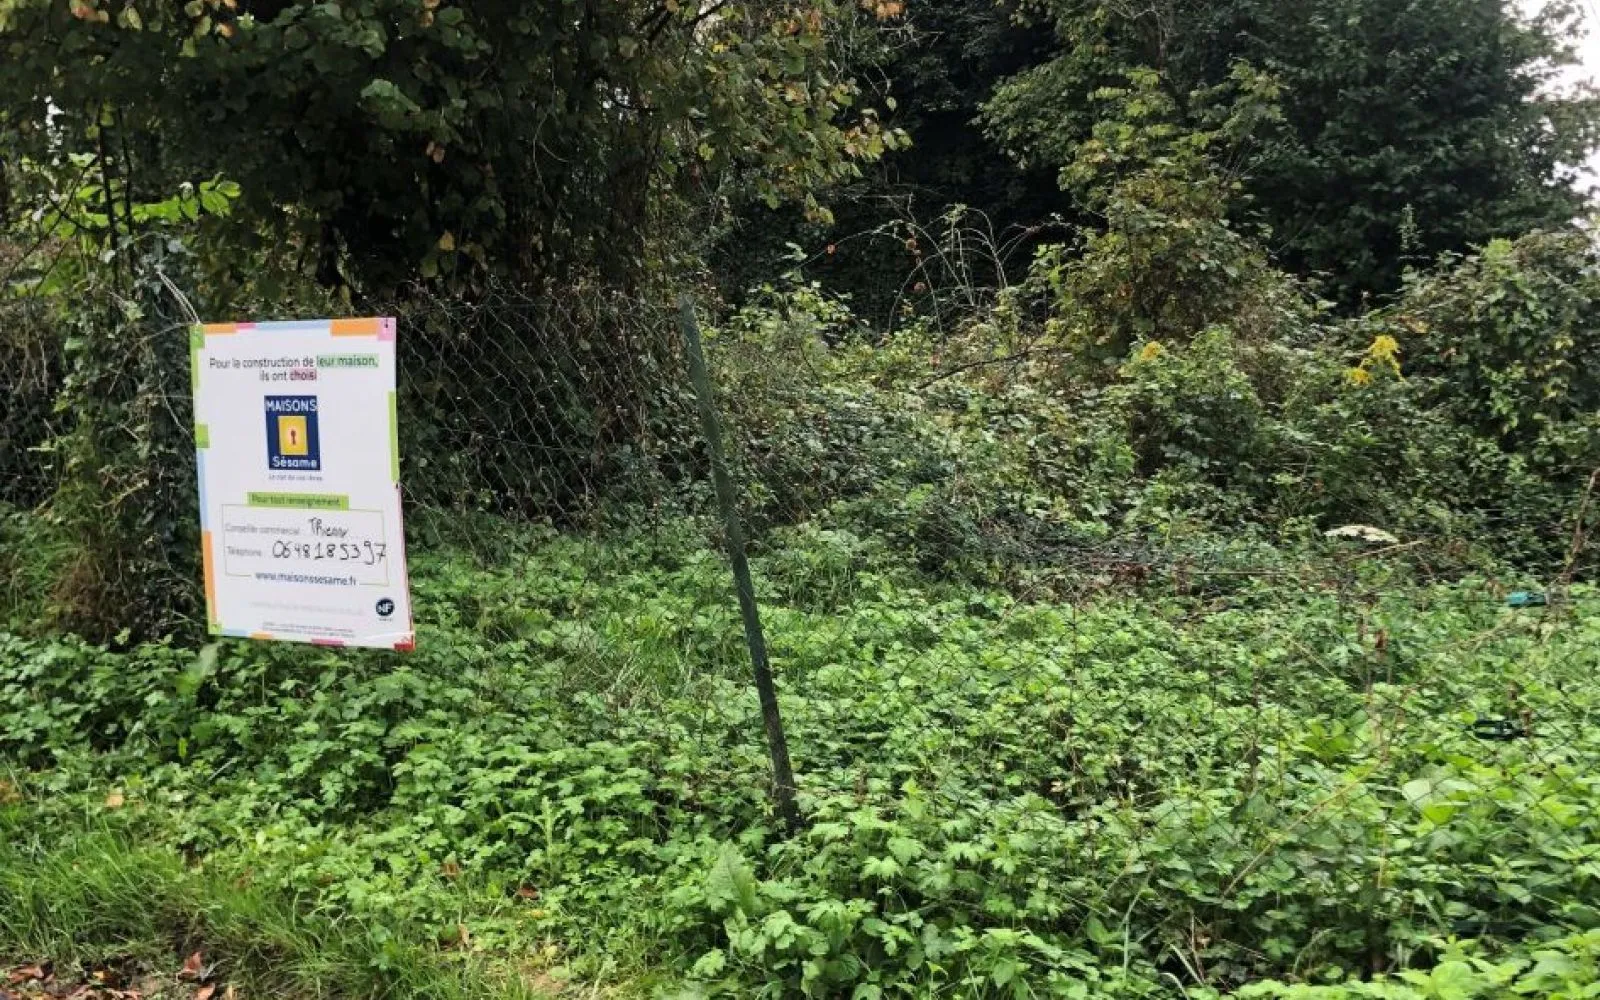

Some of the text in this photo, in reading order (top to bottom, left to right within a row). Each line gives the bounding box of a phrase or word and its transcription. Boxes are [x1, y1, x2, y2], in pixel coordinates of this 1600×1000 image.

[209, 357, 231, 369] Pour
[243, 356, 300, 368] construction
[302, 355, 315, 367] de
[317, 355, 336, 368] leur
[338, 354, 379, 368] maison,
[290, 370, 318, 381] choisi
